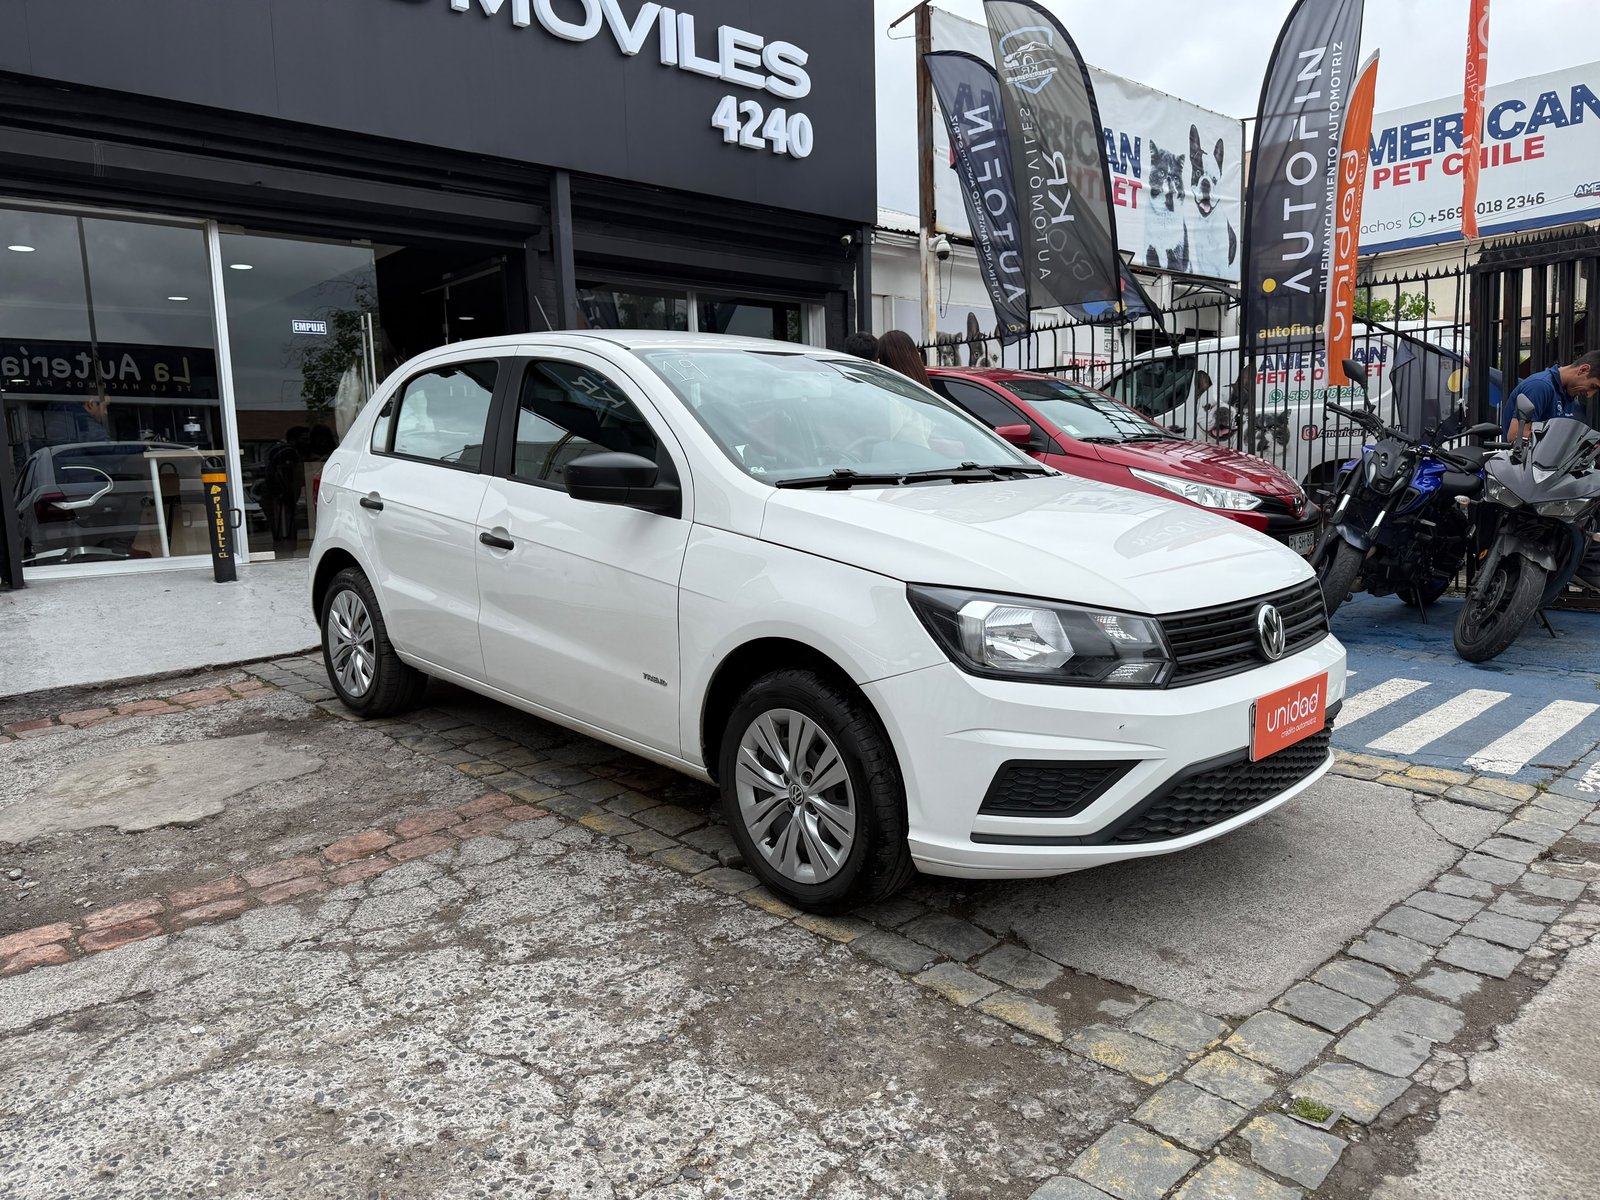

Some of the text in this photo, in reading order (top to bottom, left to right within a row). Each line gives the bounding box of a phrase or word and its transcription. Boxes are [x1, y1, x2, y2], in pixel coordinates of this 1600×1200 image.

[1328, 41, 1343, 140] AUTOMOTRIZ
[711, 95, 814, 159] 4240
[1282, 46, 1327, 294] AUTOFIN
[1373, 159, 1432, 190] PET
[1361, 217, 1402, 235] achos
[1474, 199, 1503, 215] 018
[1506, 192, 1545, 210] 2346
[1333, 149, 1359, 342] unidad
[294, 322, 325, 332] EMPUJE
[1266, 683, 1320, 733] unidad
